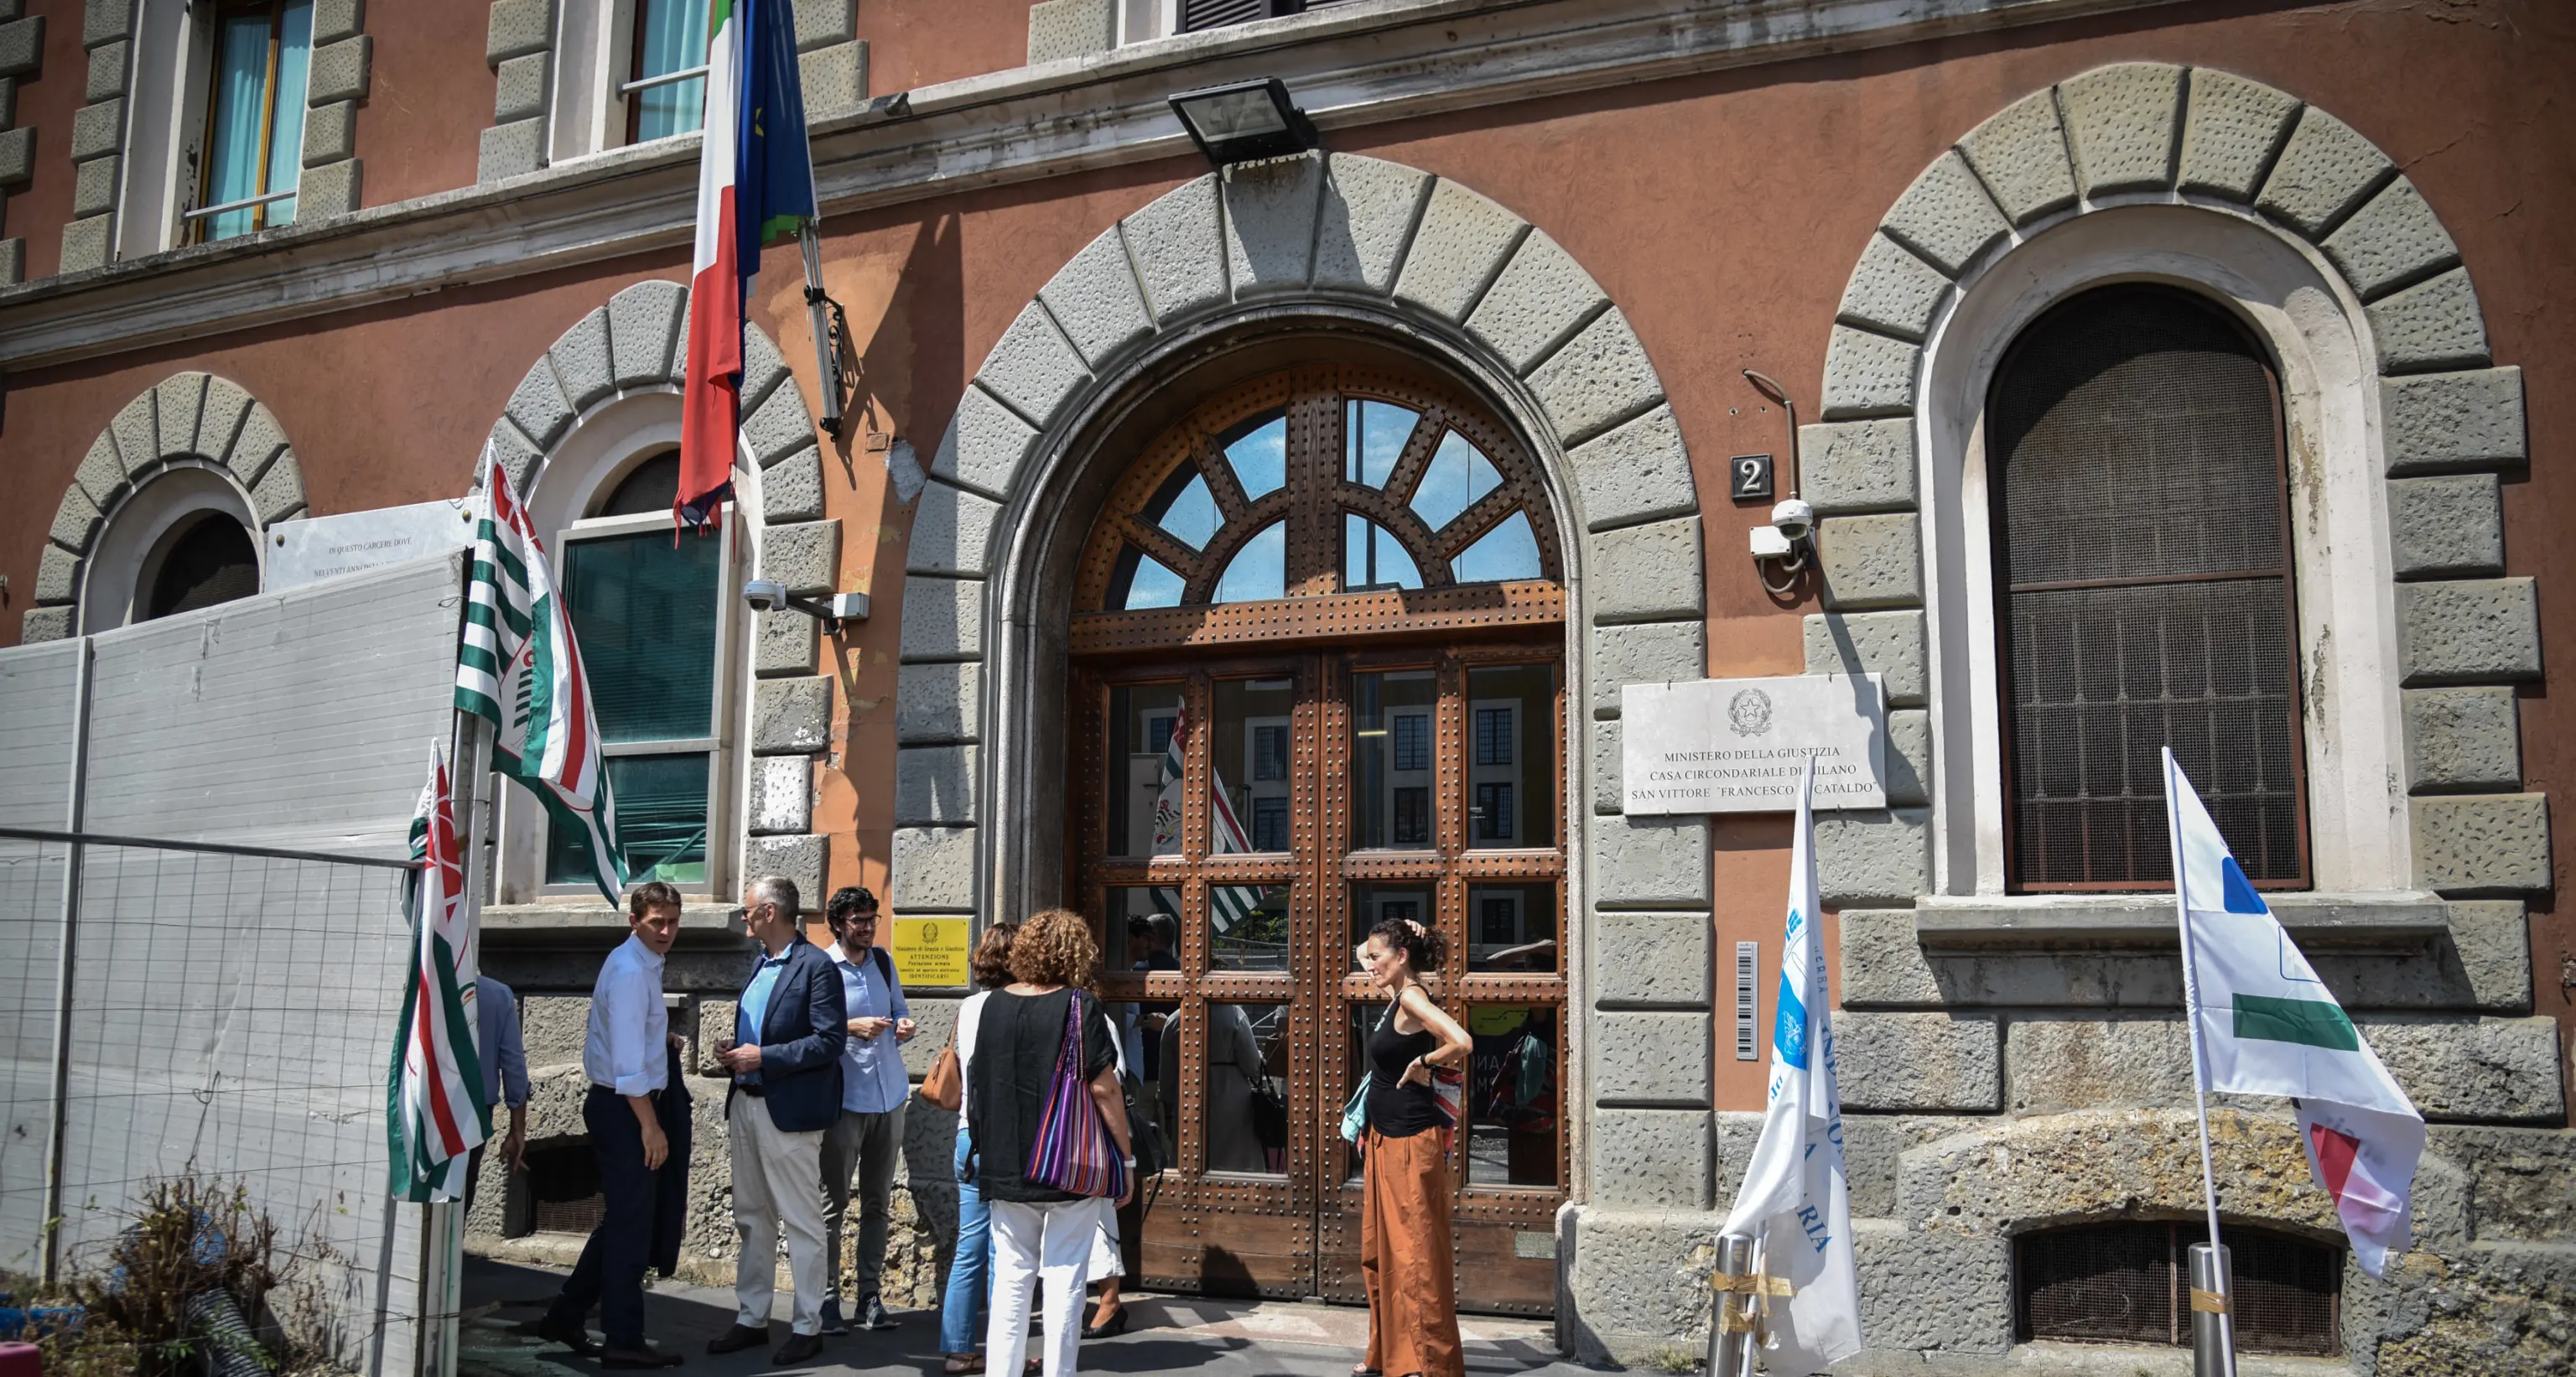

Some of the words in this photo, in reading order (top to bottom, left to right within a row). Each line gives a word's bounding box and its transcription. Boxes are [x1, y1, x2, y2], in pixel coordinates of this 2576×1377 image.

[1741, 460, 1761, 492] 2
[337, 543, 362, 554] QUESTO
[393, 537, 413, 546] DOVE
[325, 566, 345, 576] VENTI
[1665, 751, 1732, 762] MINISTERO
[1735, 749, 1774, 760] DELLA
[1778, 746, 1841, 758] GIUSTIZIA
[1649, 770, 1682, 781] CASA
[1685, 766, 1785, 780] CIRCONDARIALE
[1789, 766, 1802, 777] DI
[1631, 789, 1655, 800] SAN
[1659, 787, 1711, 799] VITTORE
[1717, 785, 1794, 798] "FRANCESCO
[1814, 781, 1877, 794] CATALDO"
